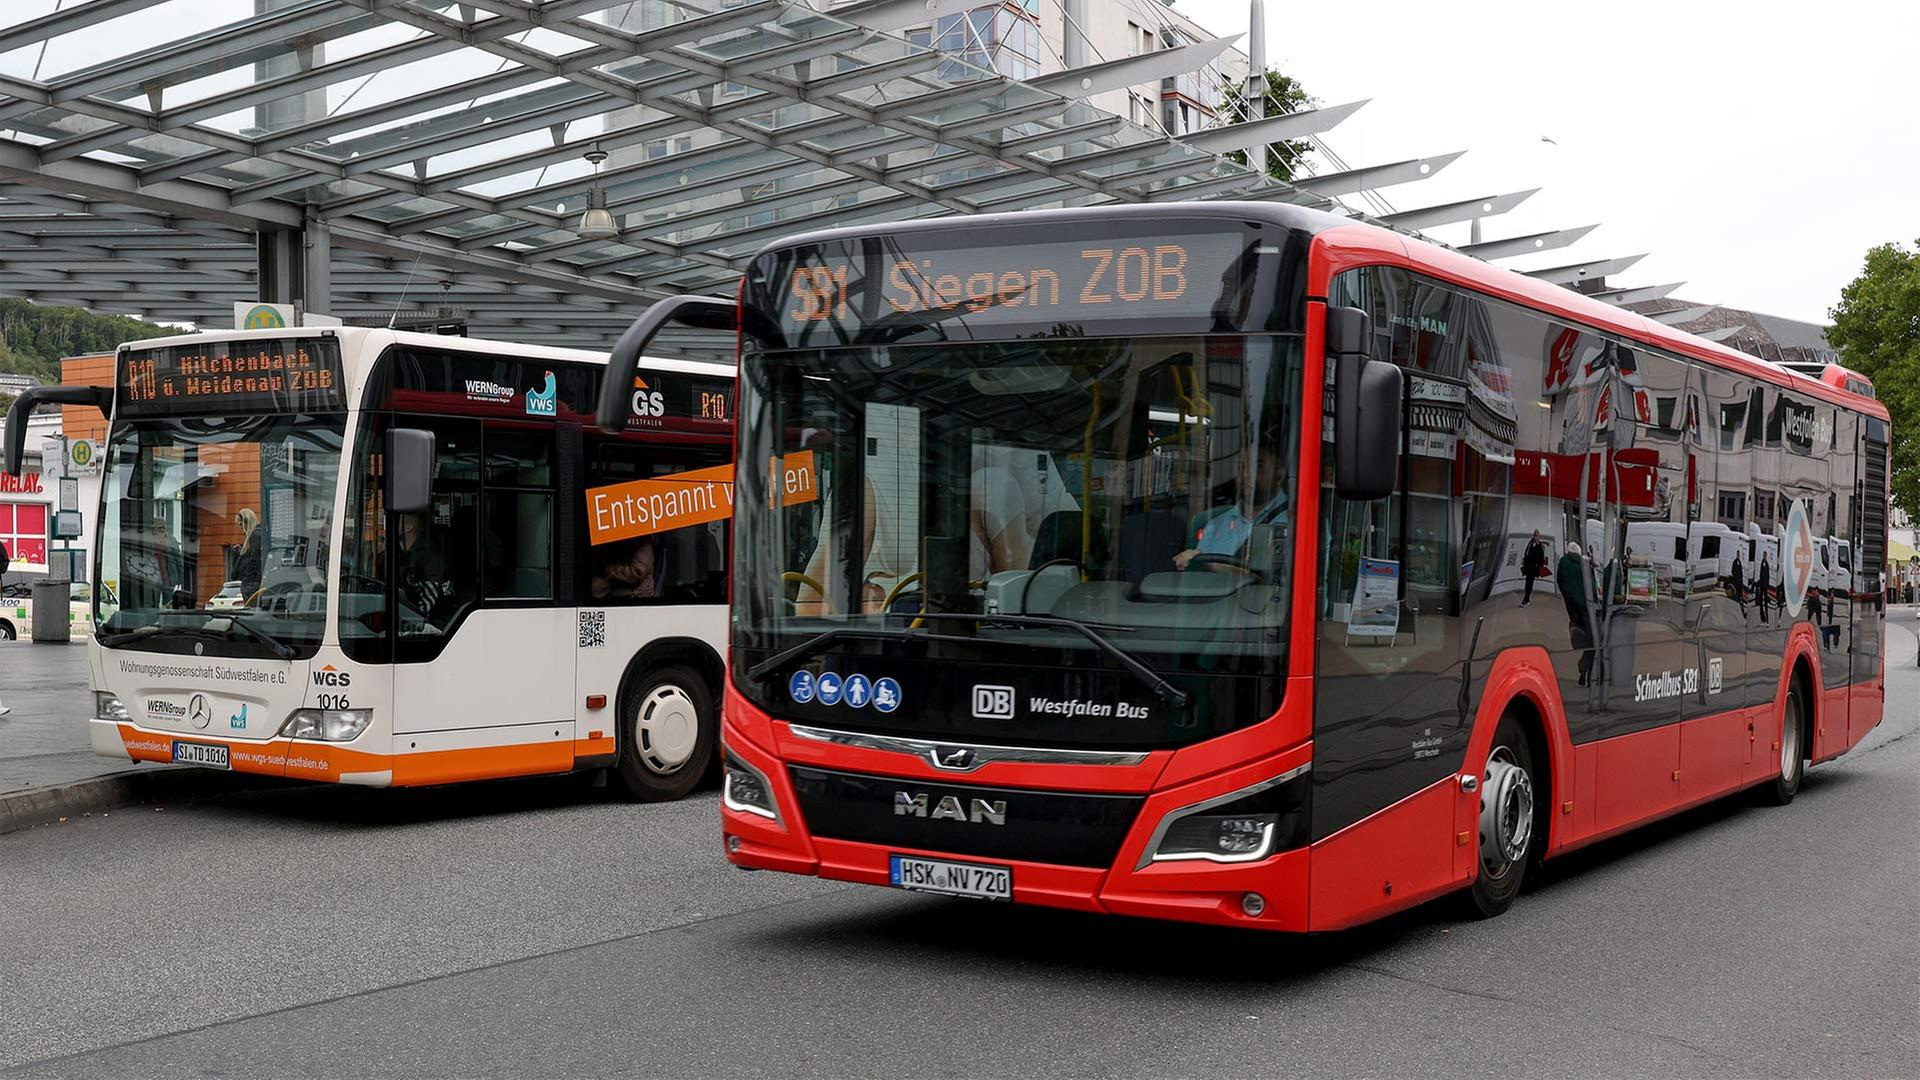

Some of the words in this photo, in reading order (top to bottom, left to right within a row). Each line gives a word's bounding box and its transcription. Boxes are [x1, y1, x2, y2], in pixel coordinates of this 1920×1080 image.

[790, 265, 848, 321] SB1
[889, 259, 1060, 314] Siegen
[1080, 244, 1188, 304] ZOB
[1420, 316, 1448, 337] MAN
[128, 359, 157, 400] R10
[180, 348, 310, 375] Hilchenbach
[163, 378, 180, 396] ü.
[187, 375, 282, 396] Weidenau
[289, 368, 332, 390] ZOB
[465, 379, 515, 398] WERNGroup
[529, 398, 553, 411] VWS
[631, 390, 665, 417] GS
[701, 391, 725, 420] R10
[1785, 406, 1819, 444] Westfalen
[1, 471, 40, 493] RELAY
[594, 479, 717, 529] Entspannt
[120, 660, 214, 679] Wohnungsgenossenschaft
[215, 665, 269, 684] Südwestfalen
[271, 671, 287, 685] e.G.
[313, 671, 351, 687] WGS
[1634, 670, 1681, 702] Schnellbus
[1682, 668, 1698, 694] SB1
[1710, 662, 1721, 690] DB
[147, 700, 187, 717] WERNGroup
[317, 694, 350, 710] 1016
[977, 688, 1010, 714] DB
[1029, 697, 1112, 718] Westfalen
[1115, 701, 1149, 719] Bus
[231, 719, 245, 728] VWS
[179, 745, 188, 760] SI
[193, 746, 204, 762] TD
[205, 748, 226, 764] 1016
[231, 751, 329, 770] www.wgs-suedwestfalen.de
[894, 790, 1006, 826] MAN
[903, 861, 936, 886] HSK
[947, 867, 970, 890] NV
[974, 870, 1007, 894] 720
